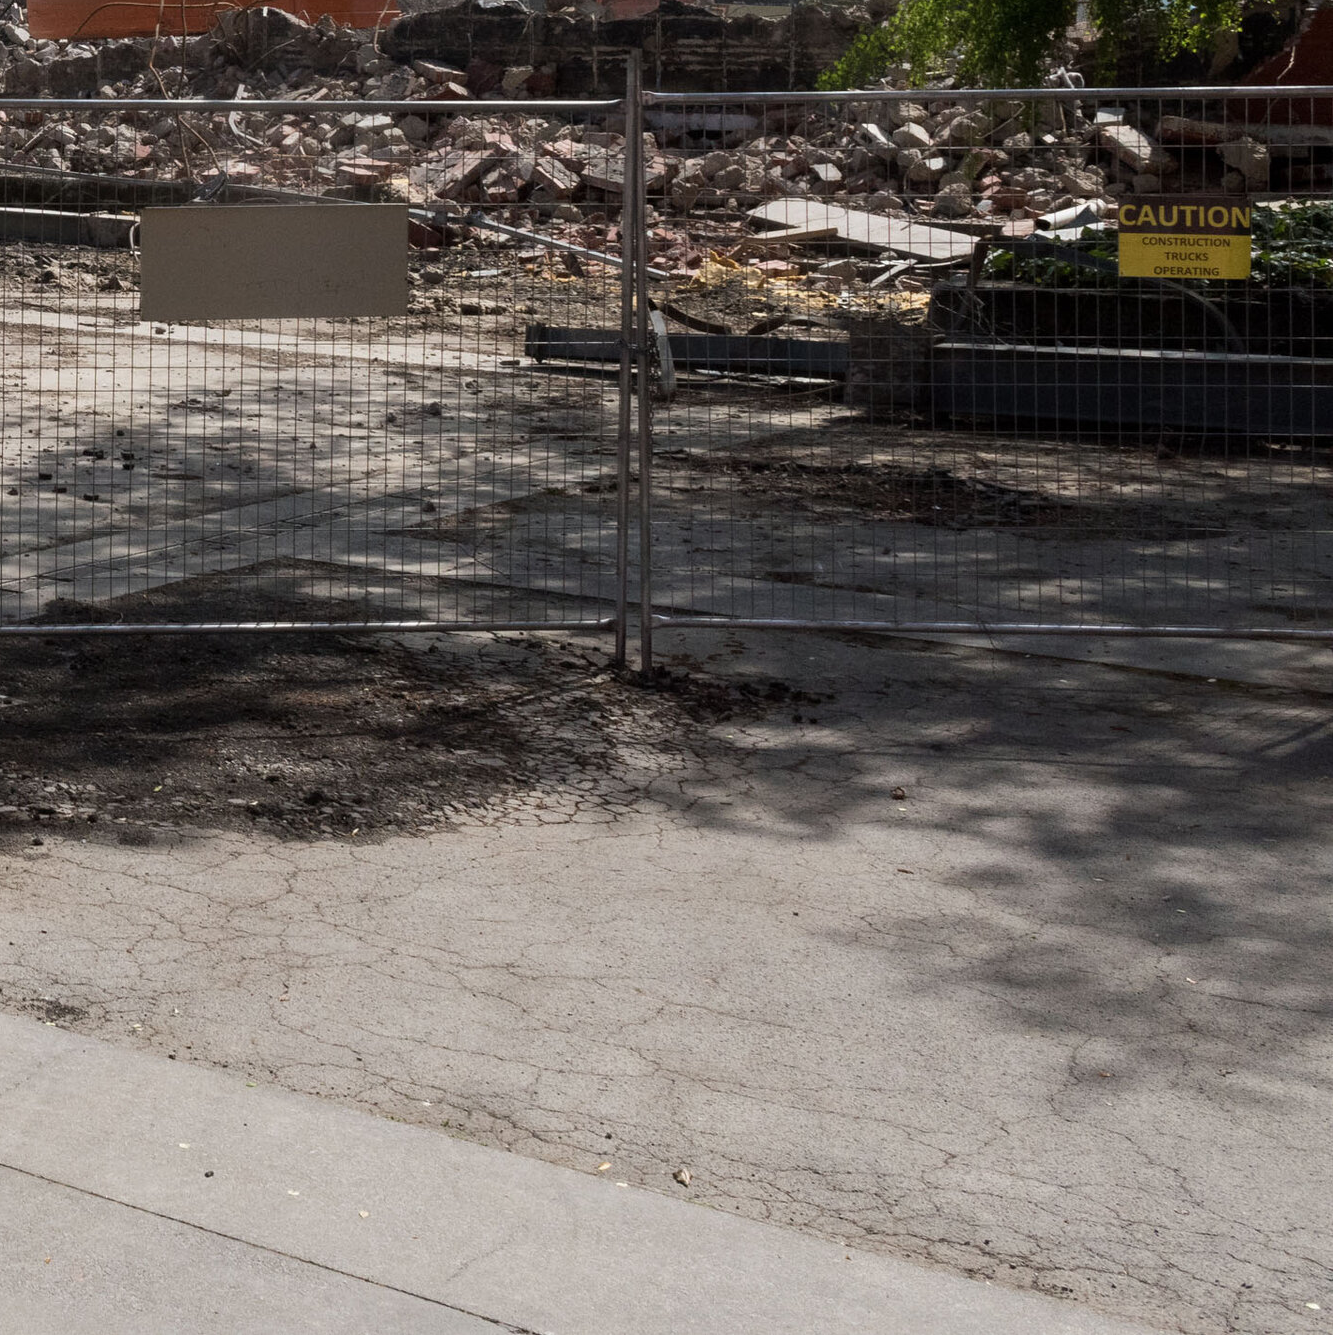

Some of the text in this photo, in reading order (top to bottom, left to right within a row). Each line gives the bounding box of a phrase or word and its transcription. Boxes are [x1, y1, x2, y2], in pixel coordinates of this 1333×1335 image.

[1119, 204, 1250, 228] CAUTION
[1142, 236, 1231, 247] CONSTRUCTION
[1164, 251, 1209, 262] TRUCKS
[1154, 266, 1220, 276] OPERATING
